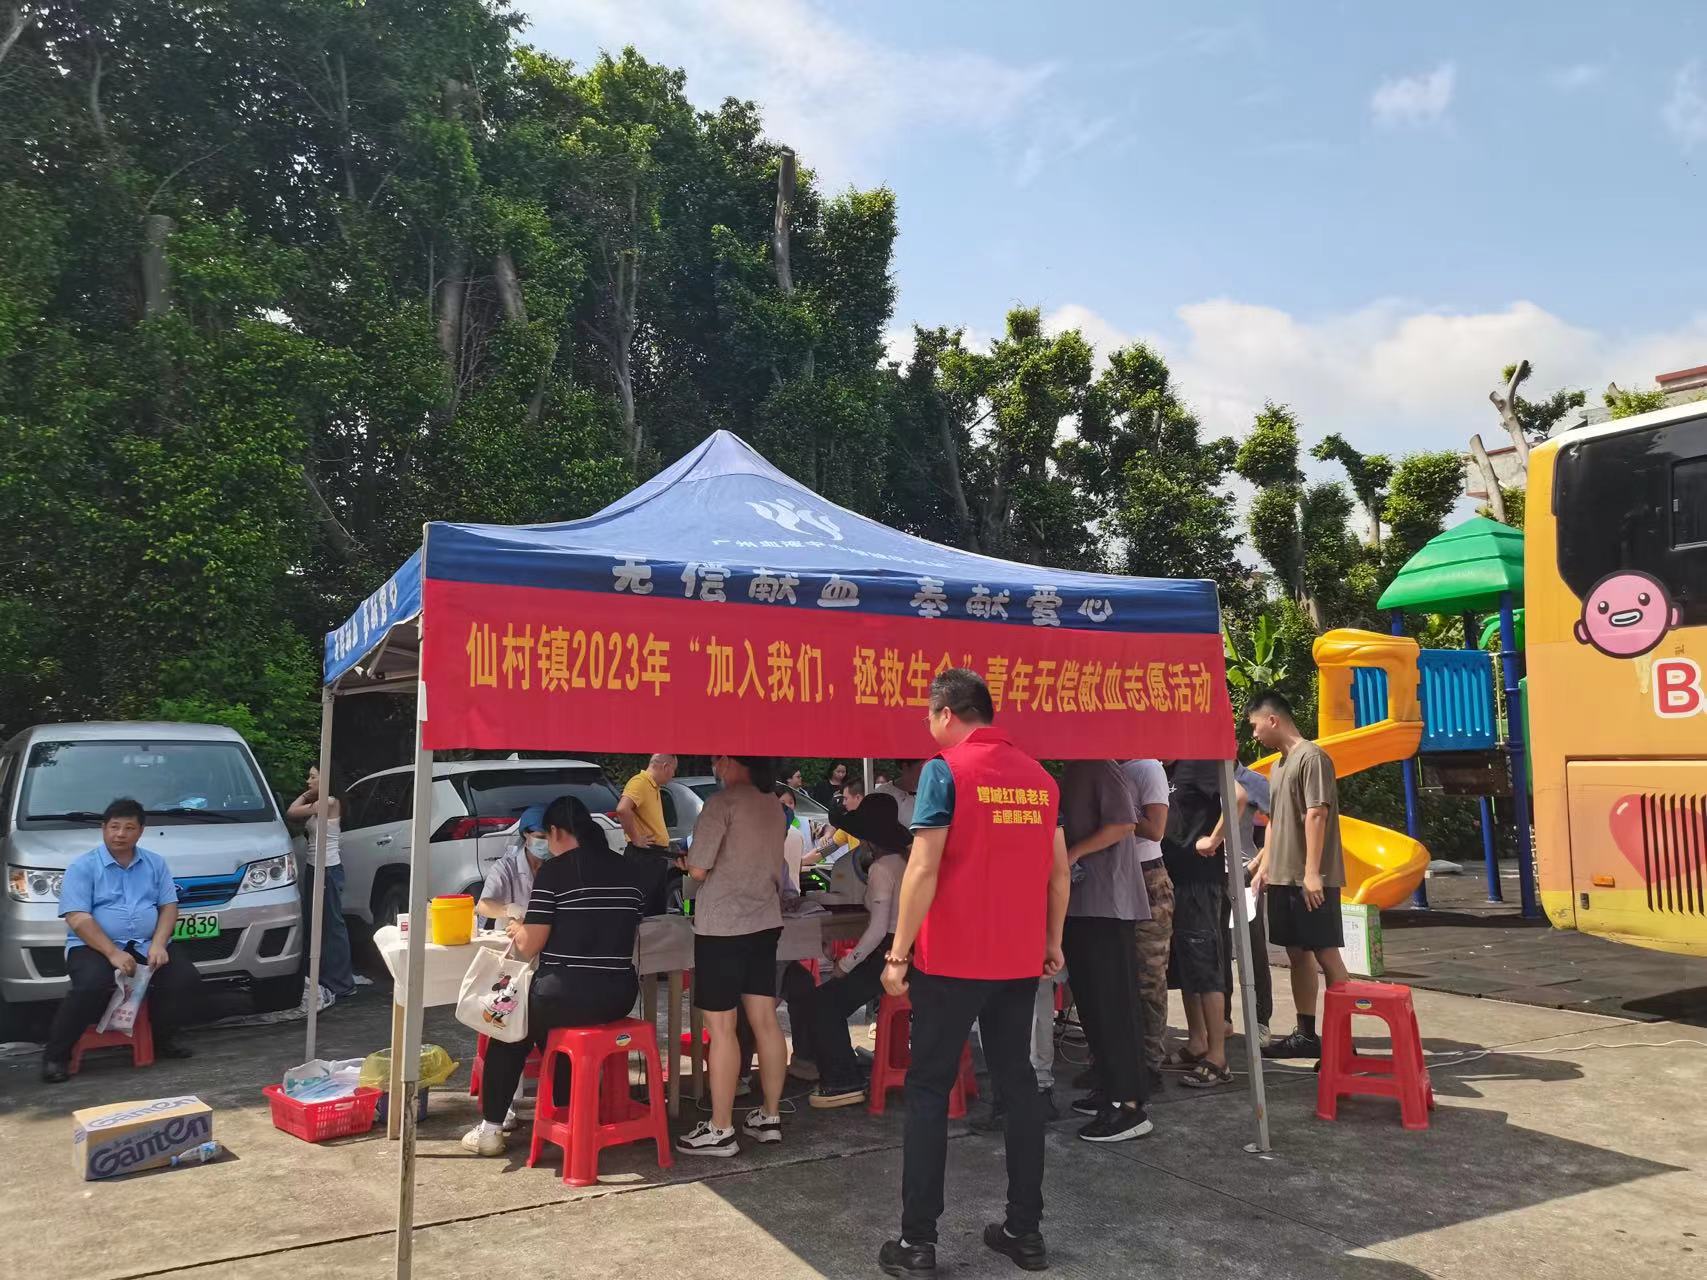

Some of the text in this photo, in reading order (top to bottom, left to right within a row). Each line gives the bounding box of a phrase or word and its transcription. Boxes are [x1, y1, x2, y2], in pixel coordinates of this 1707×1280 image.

[612, 554, 1113, 627] 无偿献血 奉献爱心
[992, 809, 1043, 825] 志愿服务队
[173, 916, 217, 936] 7839
[90, 1116, 209, 1176] Ganten
